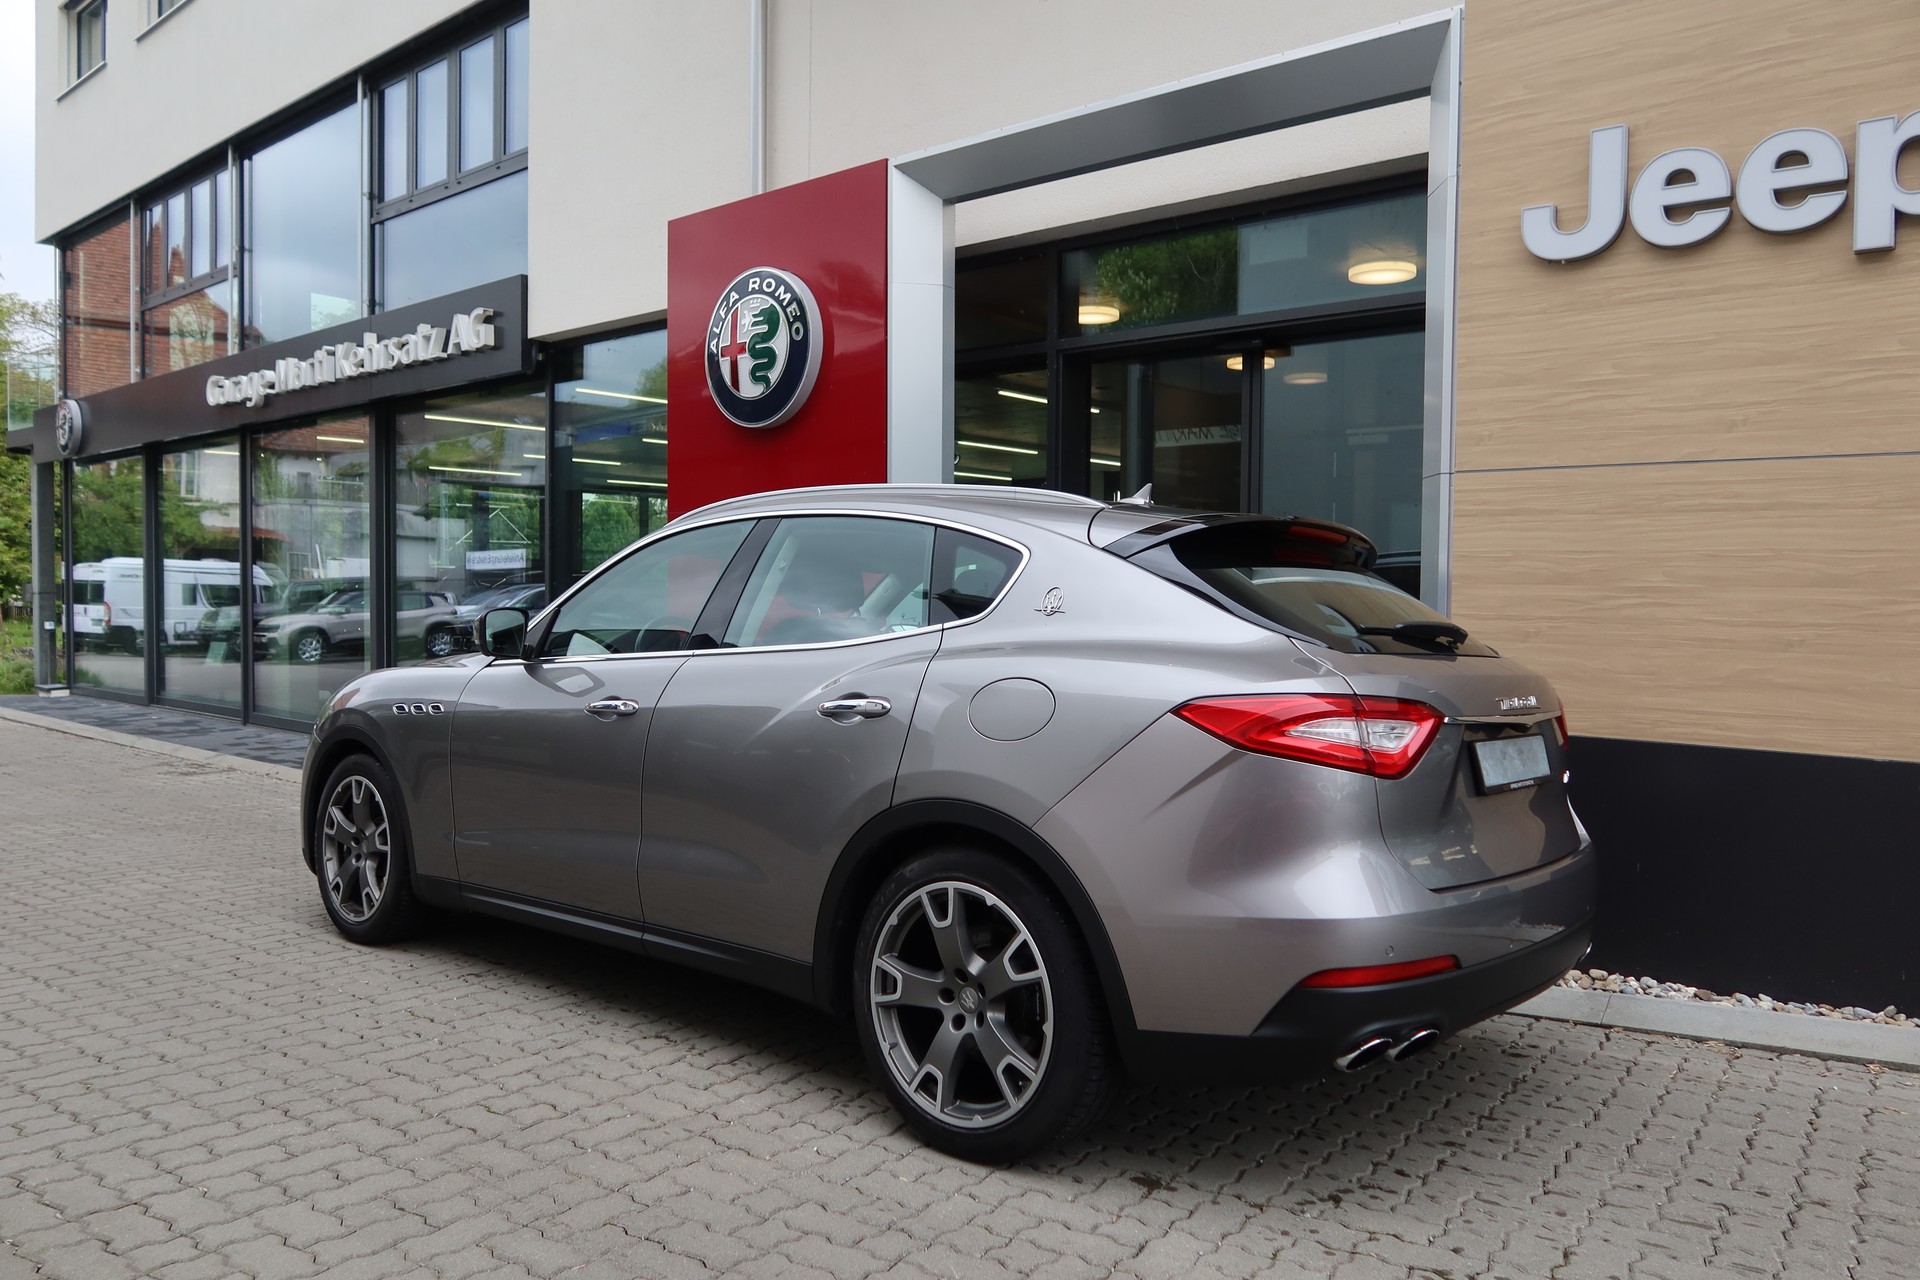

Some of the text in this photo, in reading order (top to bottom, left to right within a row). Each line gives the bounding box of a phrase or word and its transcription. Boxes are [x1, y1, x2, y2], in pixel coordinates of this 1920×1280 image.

[1520, 109, 1920, 263] Jeep
[206, 306, 495, 408] Garage Marti Kehrsatz AG
[710, 277, 804, 354] ALFA ROMEO
